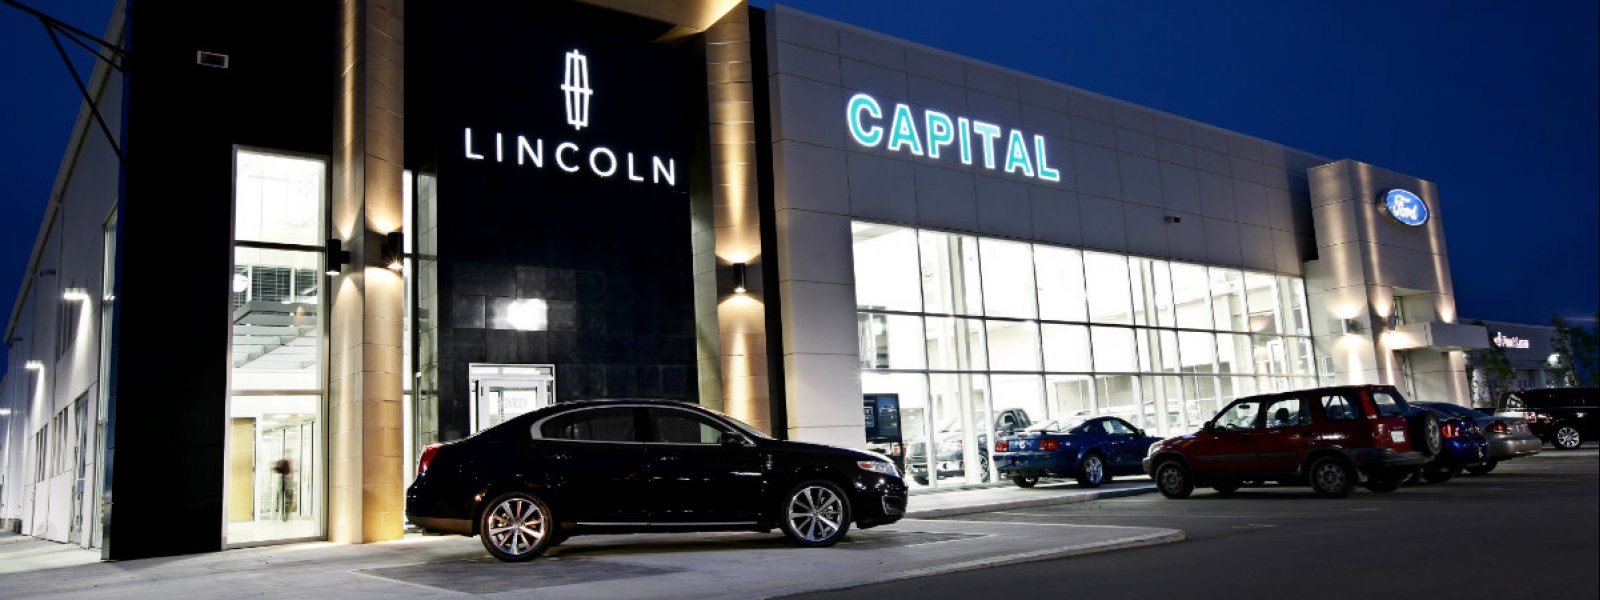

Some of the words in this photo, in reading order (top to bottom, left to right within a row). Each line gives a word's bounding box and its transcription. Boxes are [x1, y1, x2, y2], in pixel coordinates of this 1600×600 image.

[464, 127, 676, 187] LINCOLN
[847, 93, 1061, 182] CAPITAL
[1393, 195, 1418, 220] Ford
